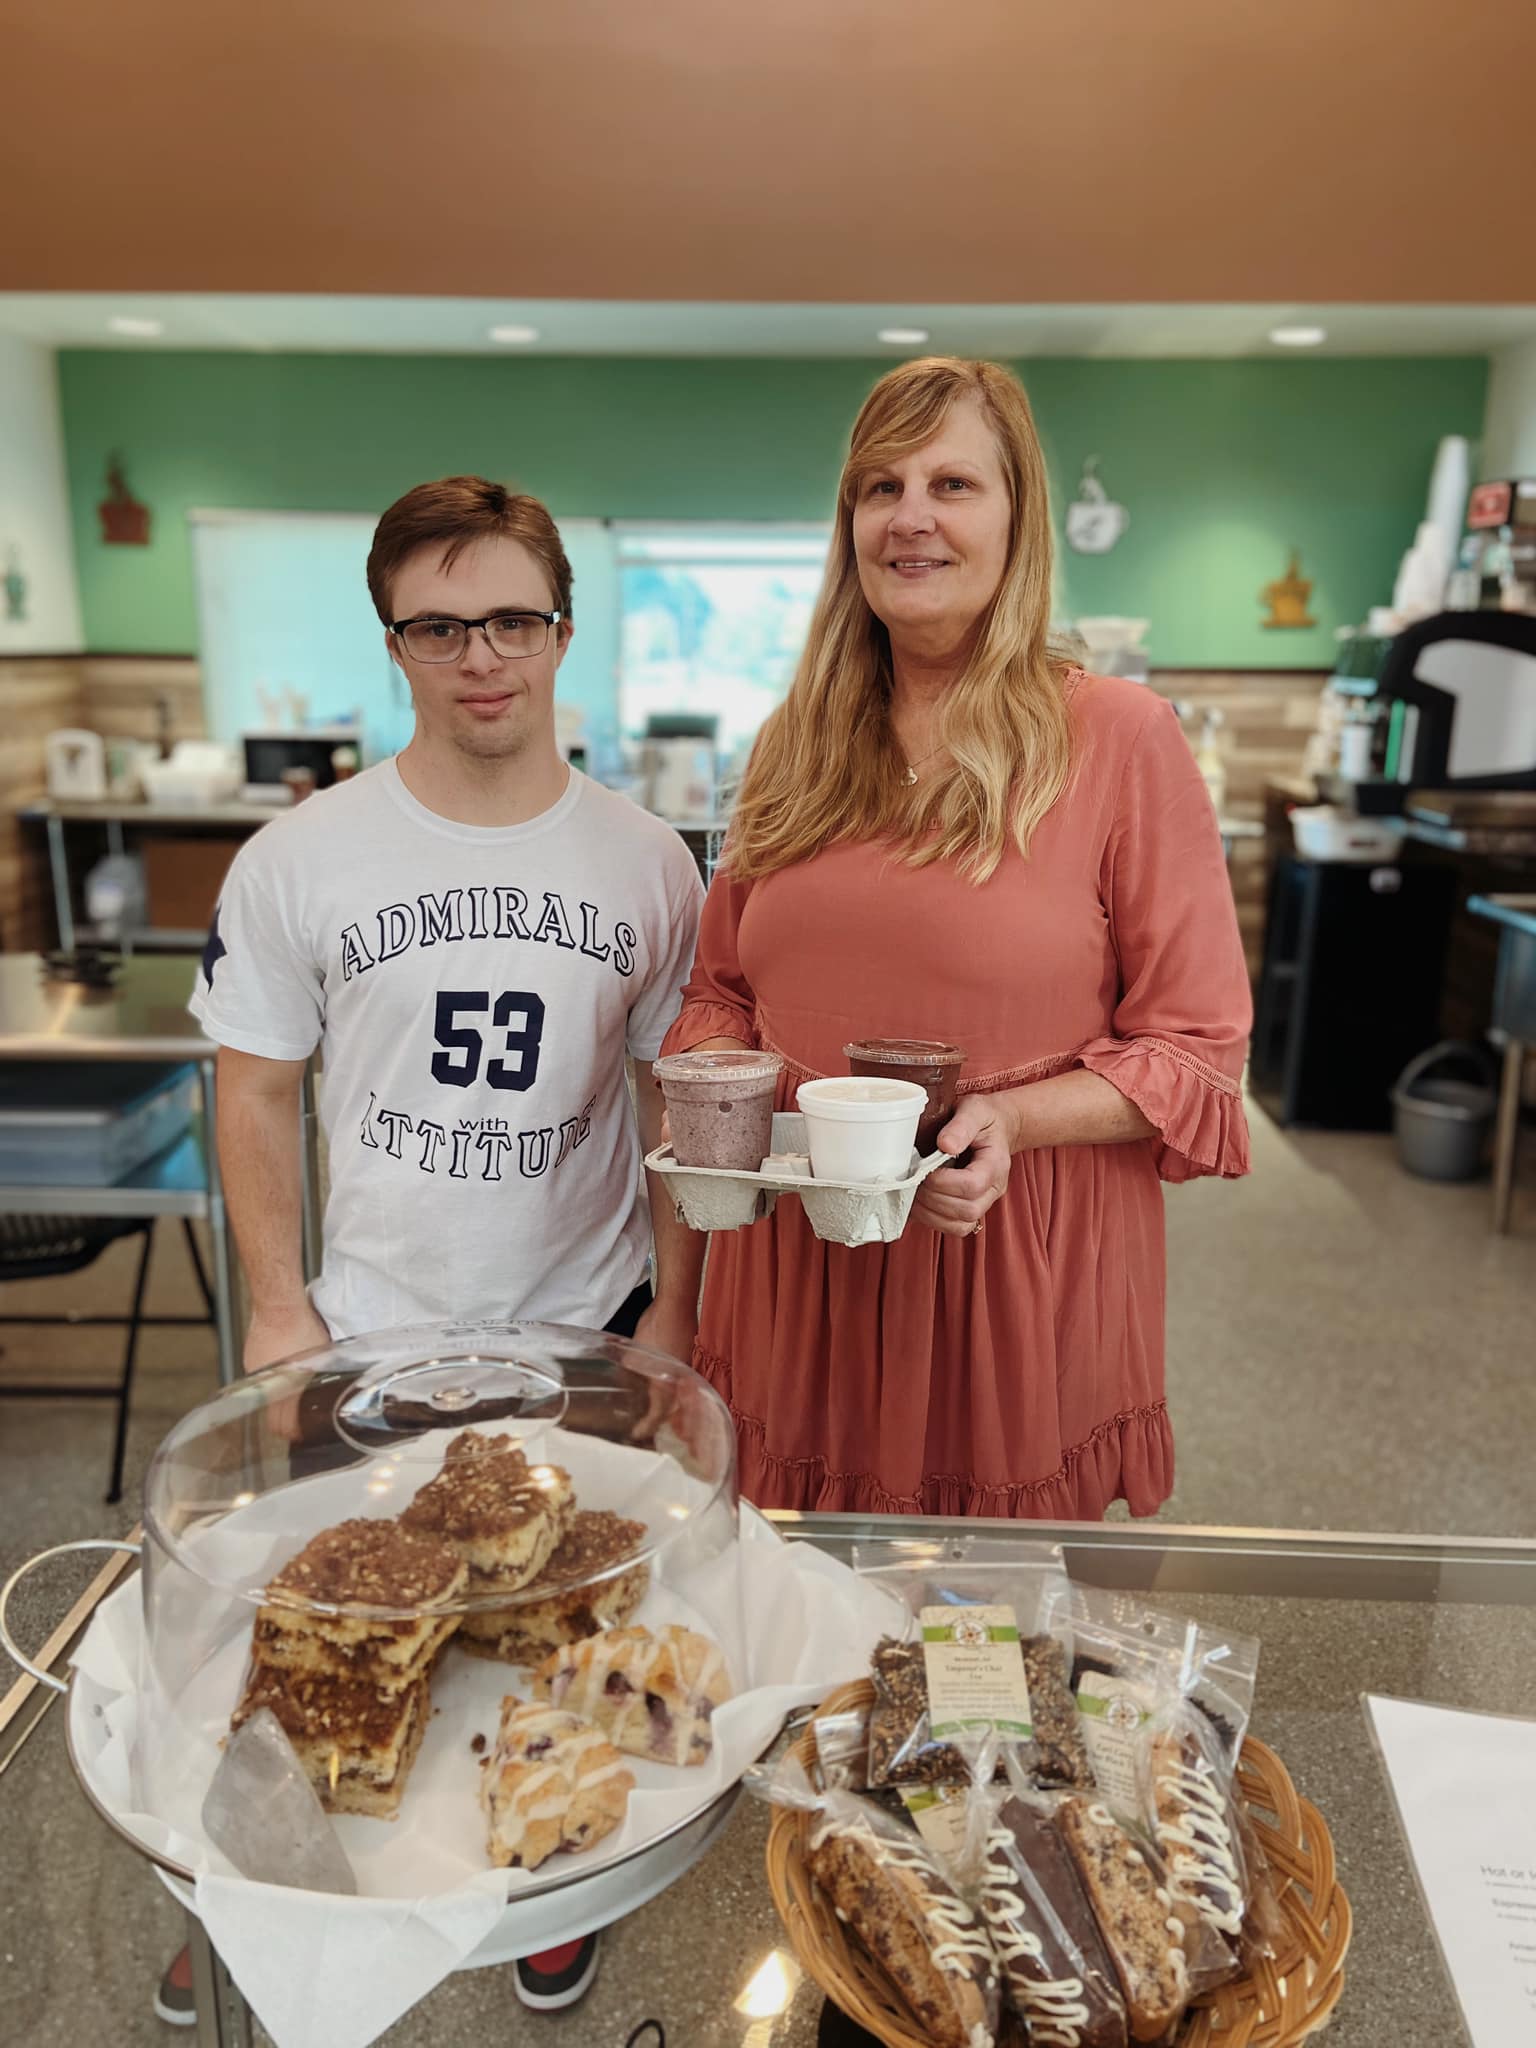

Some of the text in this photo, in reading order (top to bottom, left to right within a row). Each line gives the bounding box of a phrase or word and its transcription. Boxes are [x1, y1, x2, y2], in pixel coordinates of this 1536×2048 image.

[341, 887, 637, 981] ADMIRALS
[431, 990, 546, 1092] 53
[459, 1118, 508, 1131] with
